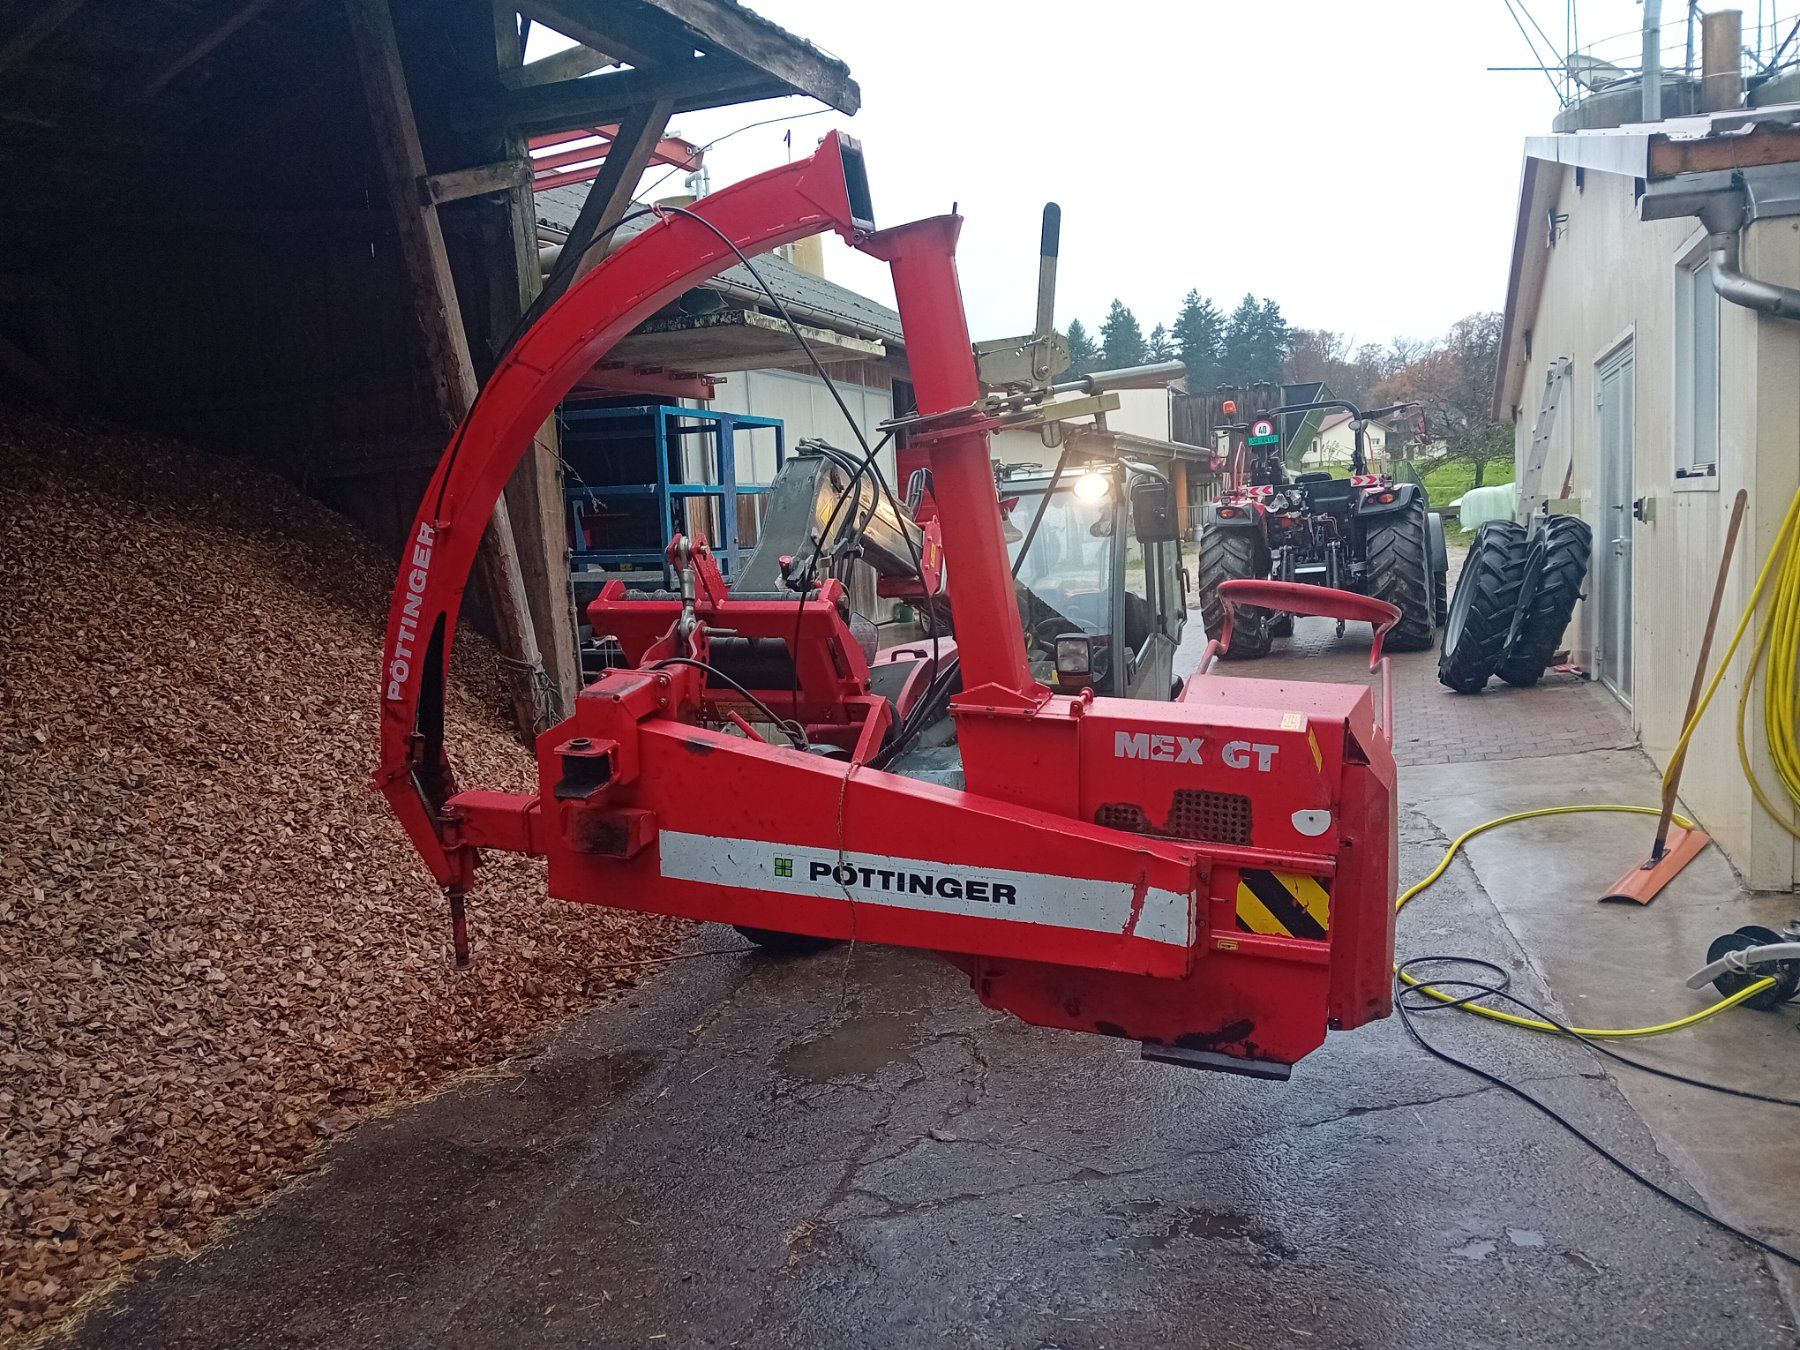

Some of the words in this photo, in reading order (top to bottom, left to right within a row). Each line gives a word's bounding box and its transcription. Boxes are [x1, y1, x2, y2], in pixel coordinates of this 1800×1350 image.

[1258, 425, 1267, 434] 40
[387, 521, 436, 700] PÖTTINGER
[1114, 731, 1204, 765] MEX
[1221, 740, 1279, 772] GT
[809, 861, 1017, 905] PÖTTINGER
